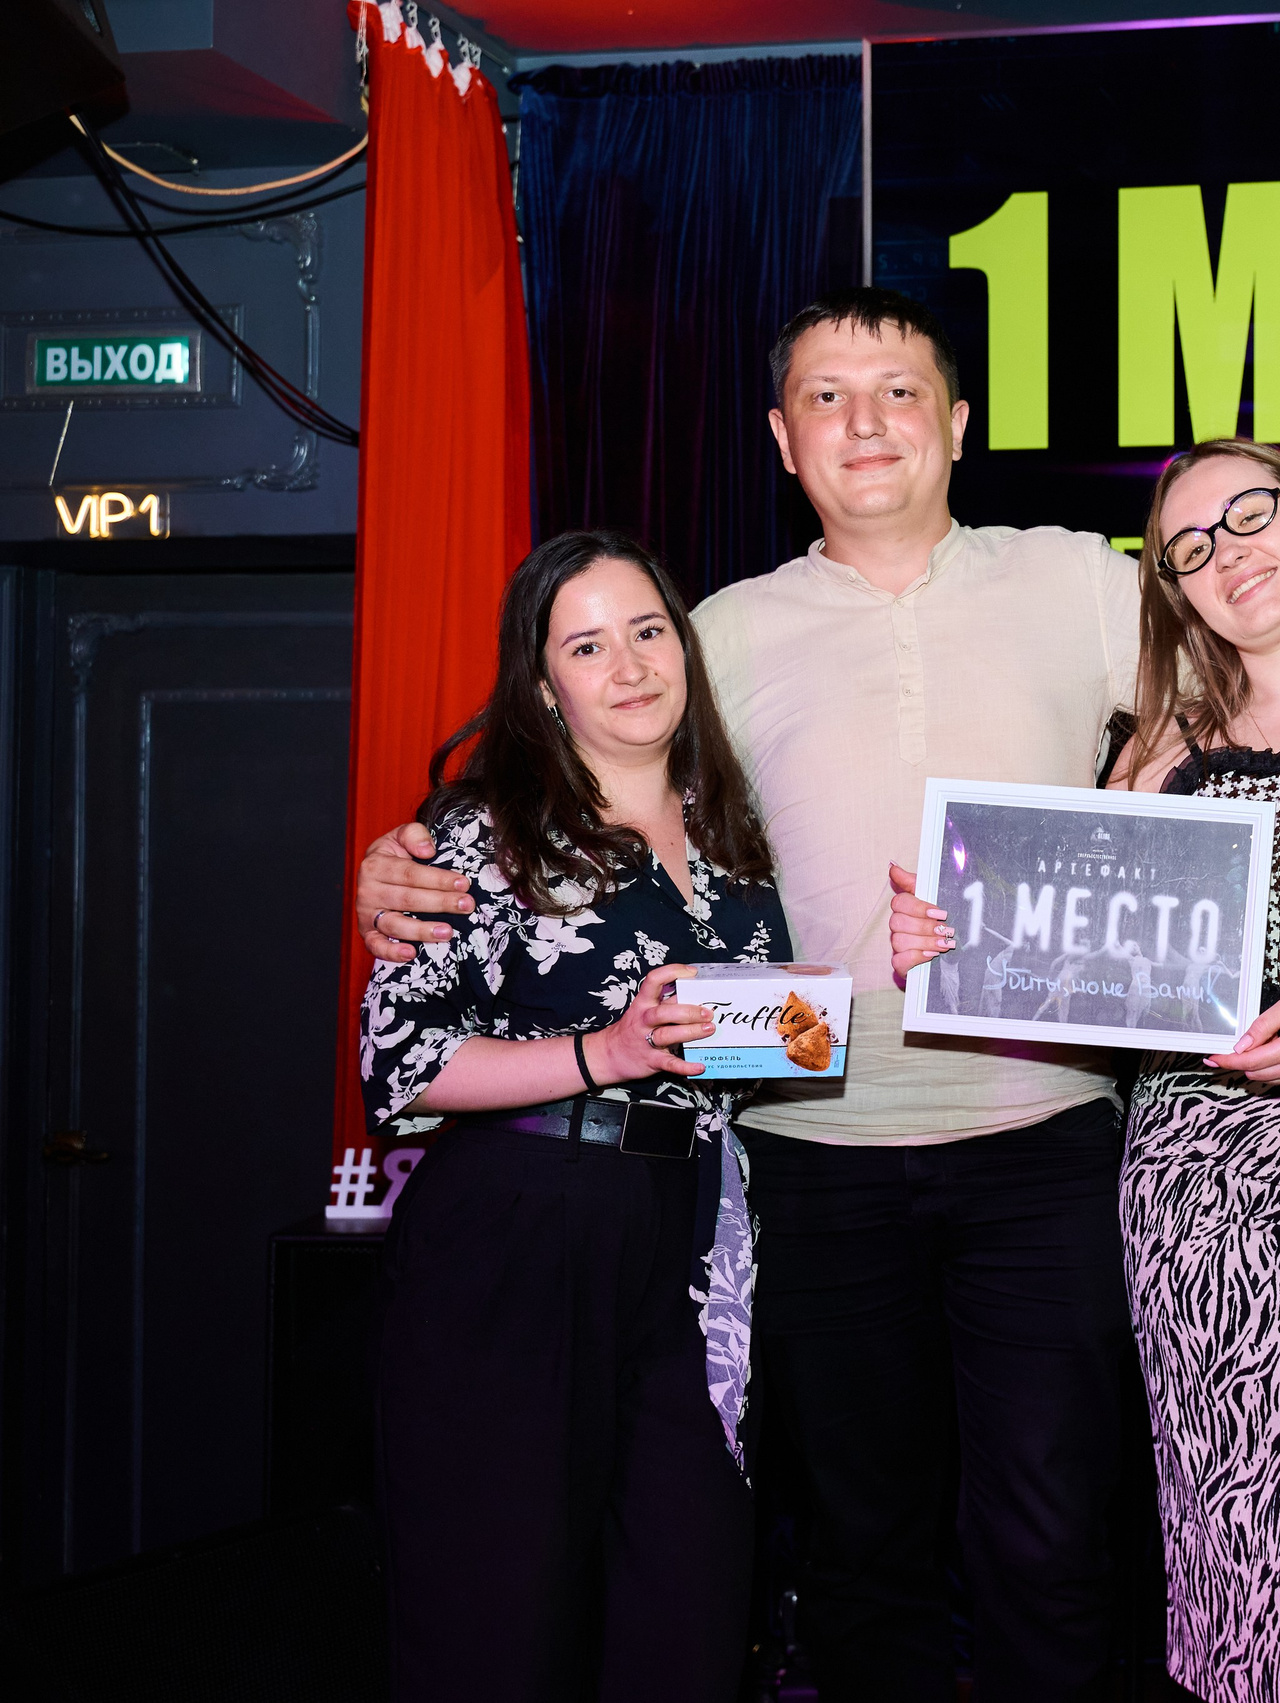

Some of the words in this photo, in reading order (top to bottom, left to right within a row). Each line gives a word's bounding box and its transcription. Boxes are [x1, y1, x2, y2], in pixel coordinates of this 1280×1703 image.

[949, 191, 1050, 450] 1
[46, 342, 184, 384] ВЫХОД
[1038, 859, 1157, 881] АРТЕФАКТ
[963, 880, 985, 948] 1
[1012, 881, 1221, 964] МЕСТО
